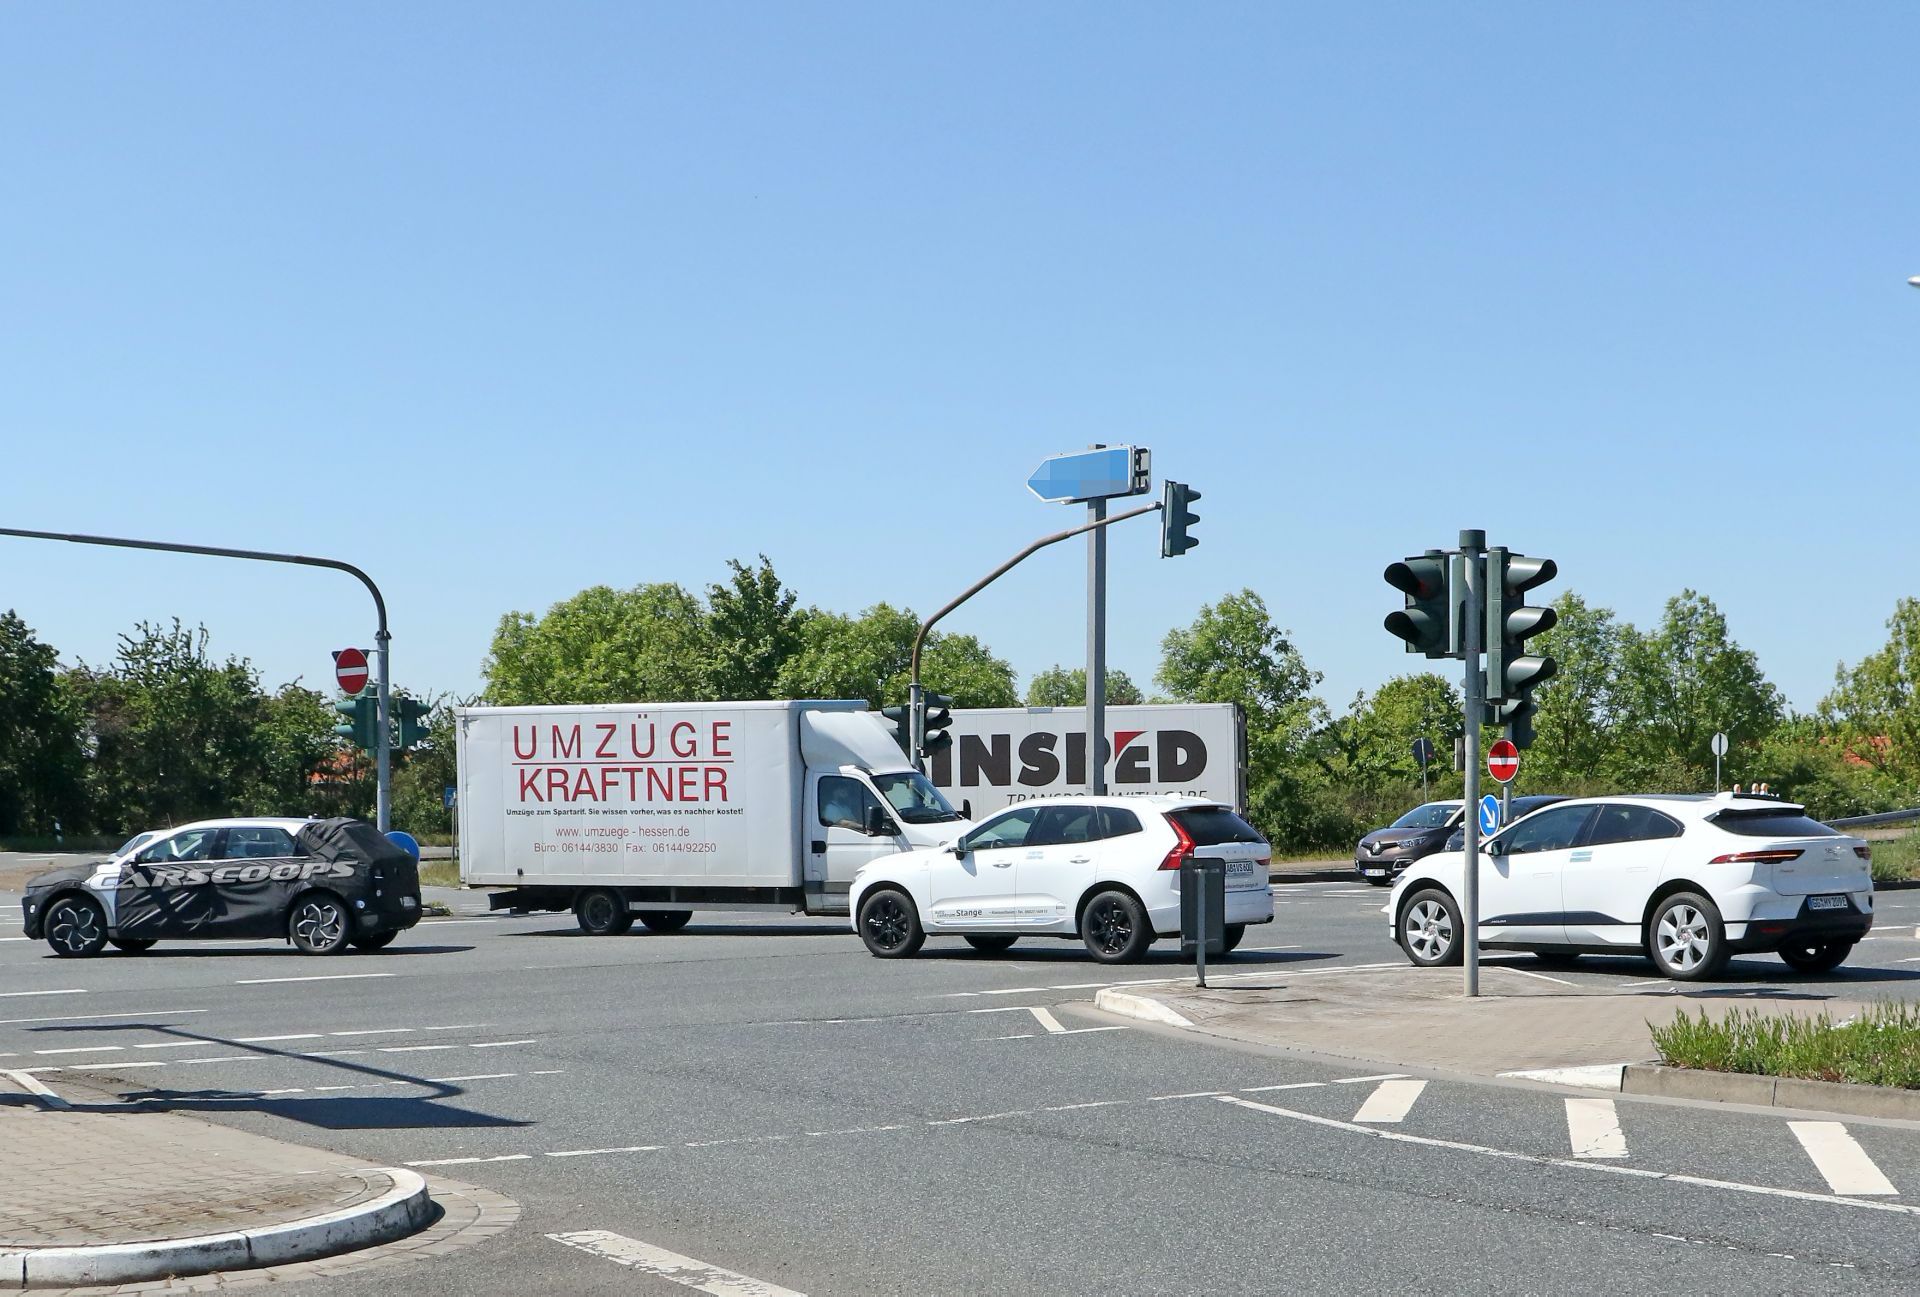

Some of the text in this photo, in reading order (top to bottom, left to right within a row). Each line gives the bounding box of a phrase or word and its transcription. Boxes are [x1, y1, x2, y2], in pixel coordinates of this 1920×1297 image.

[513, 713, 732, 760] UMZÜGE
[520, 767, 728, 802] KRAFTNER
[506, 807, 535, 817] Umzüge
[588, 807, 600, 816] Sie
[601, 808, 628, 816] wissen
[684, 807, 715, 816] nachher
[716, 807, 744, 816] kostet!
[555, 828, 581, 837] www.
[584, 828, 629, 839] umzuege
[638, 825, 690, 837] hessen.de
[534, 842, 717, 853] Büro: 06144/3830 Fax: 06144/92250
[956, 909, 983, 917] Stange
